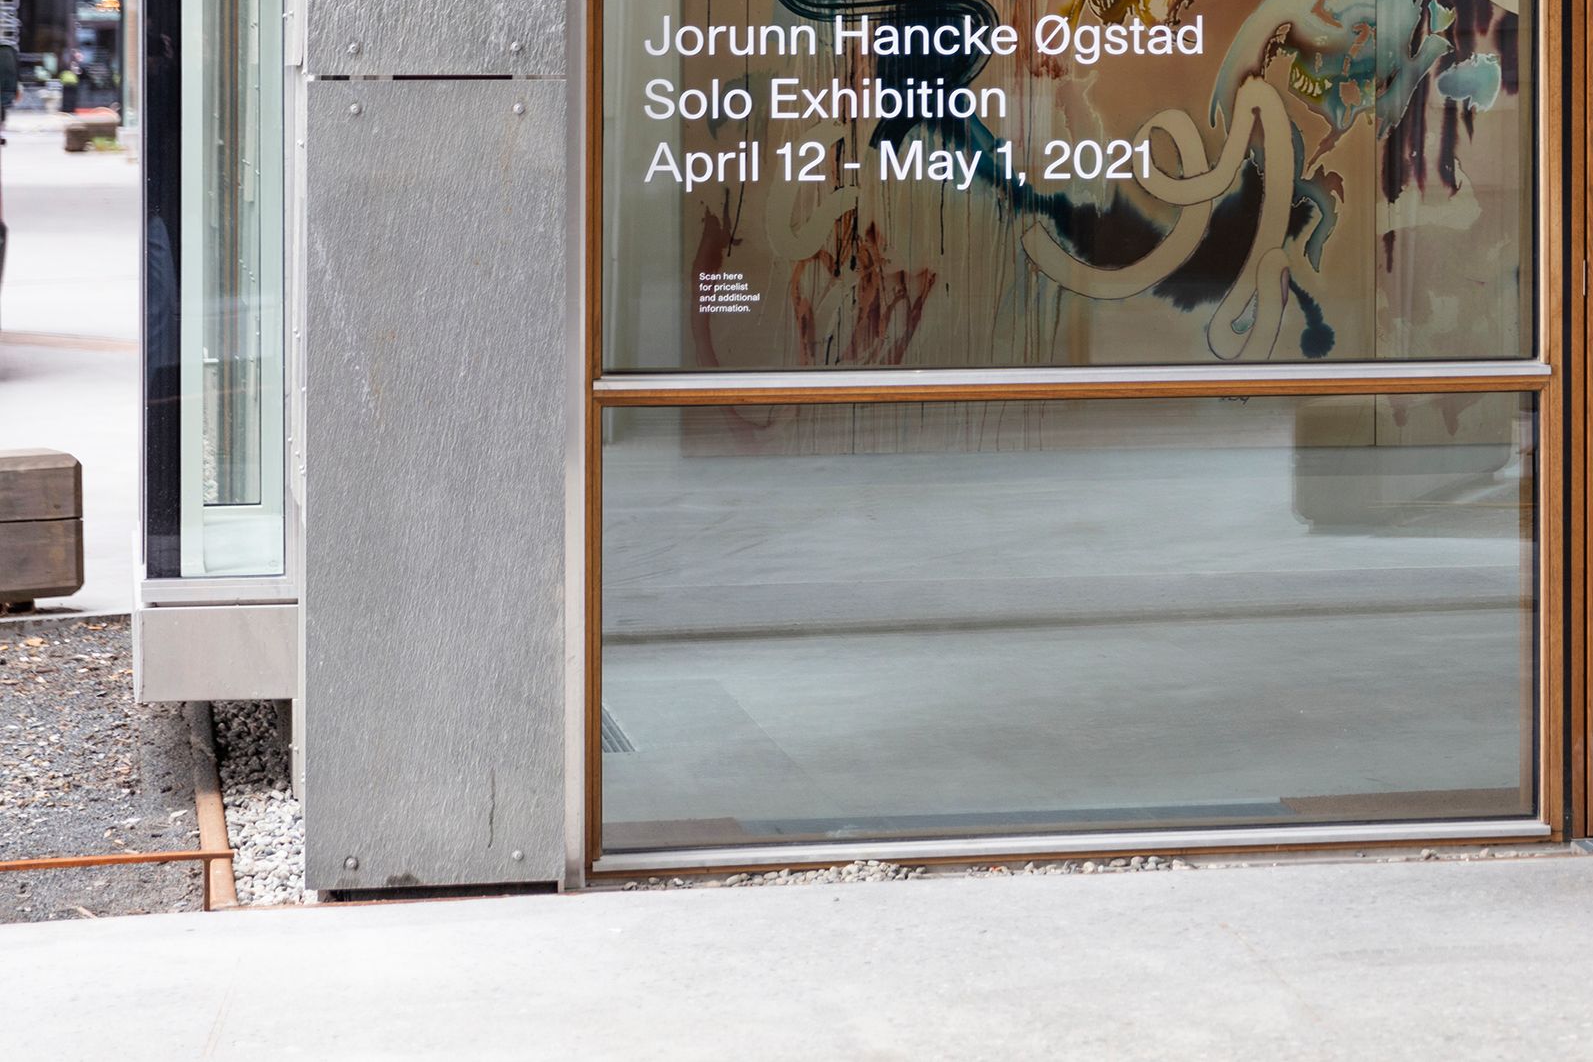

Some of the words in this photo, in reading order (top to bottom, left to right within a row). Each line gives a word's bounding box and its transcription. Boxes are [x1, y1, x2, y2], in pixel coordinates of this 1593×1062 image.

[644, 15, 816, 56] Jorunn
[835, 14, 1018, 56] Hancke
[1034, 14, 1204, 65] Øgstad
[643, 78, 753, 120] Solo
[771, 77, 1007, 119] Exhibition
[644, 141, 759, 193] April
[776, 141, 826, 182] 12
[880, 140, 982, 191] May
[996, 140, 1026, 187] 1,
[1043, 139, 1150, 180] 2021
[699, 272, 721, 281] Scan
[723, 272, 743, 281] here
[699, 283, 712, 291] for
[714, 283, 748, 292] pricelist
[699, 293, 716, 302] and
[718, 293, 760, 302] additional
[699, 304, 750, 313] information.
